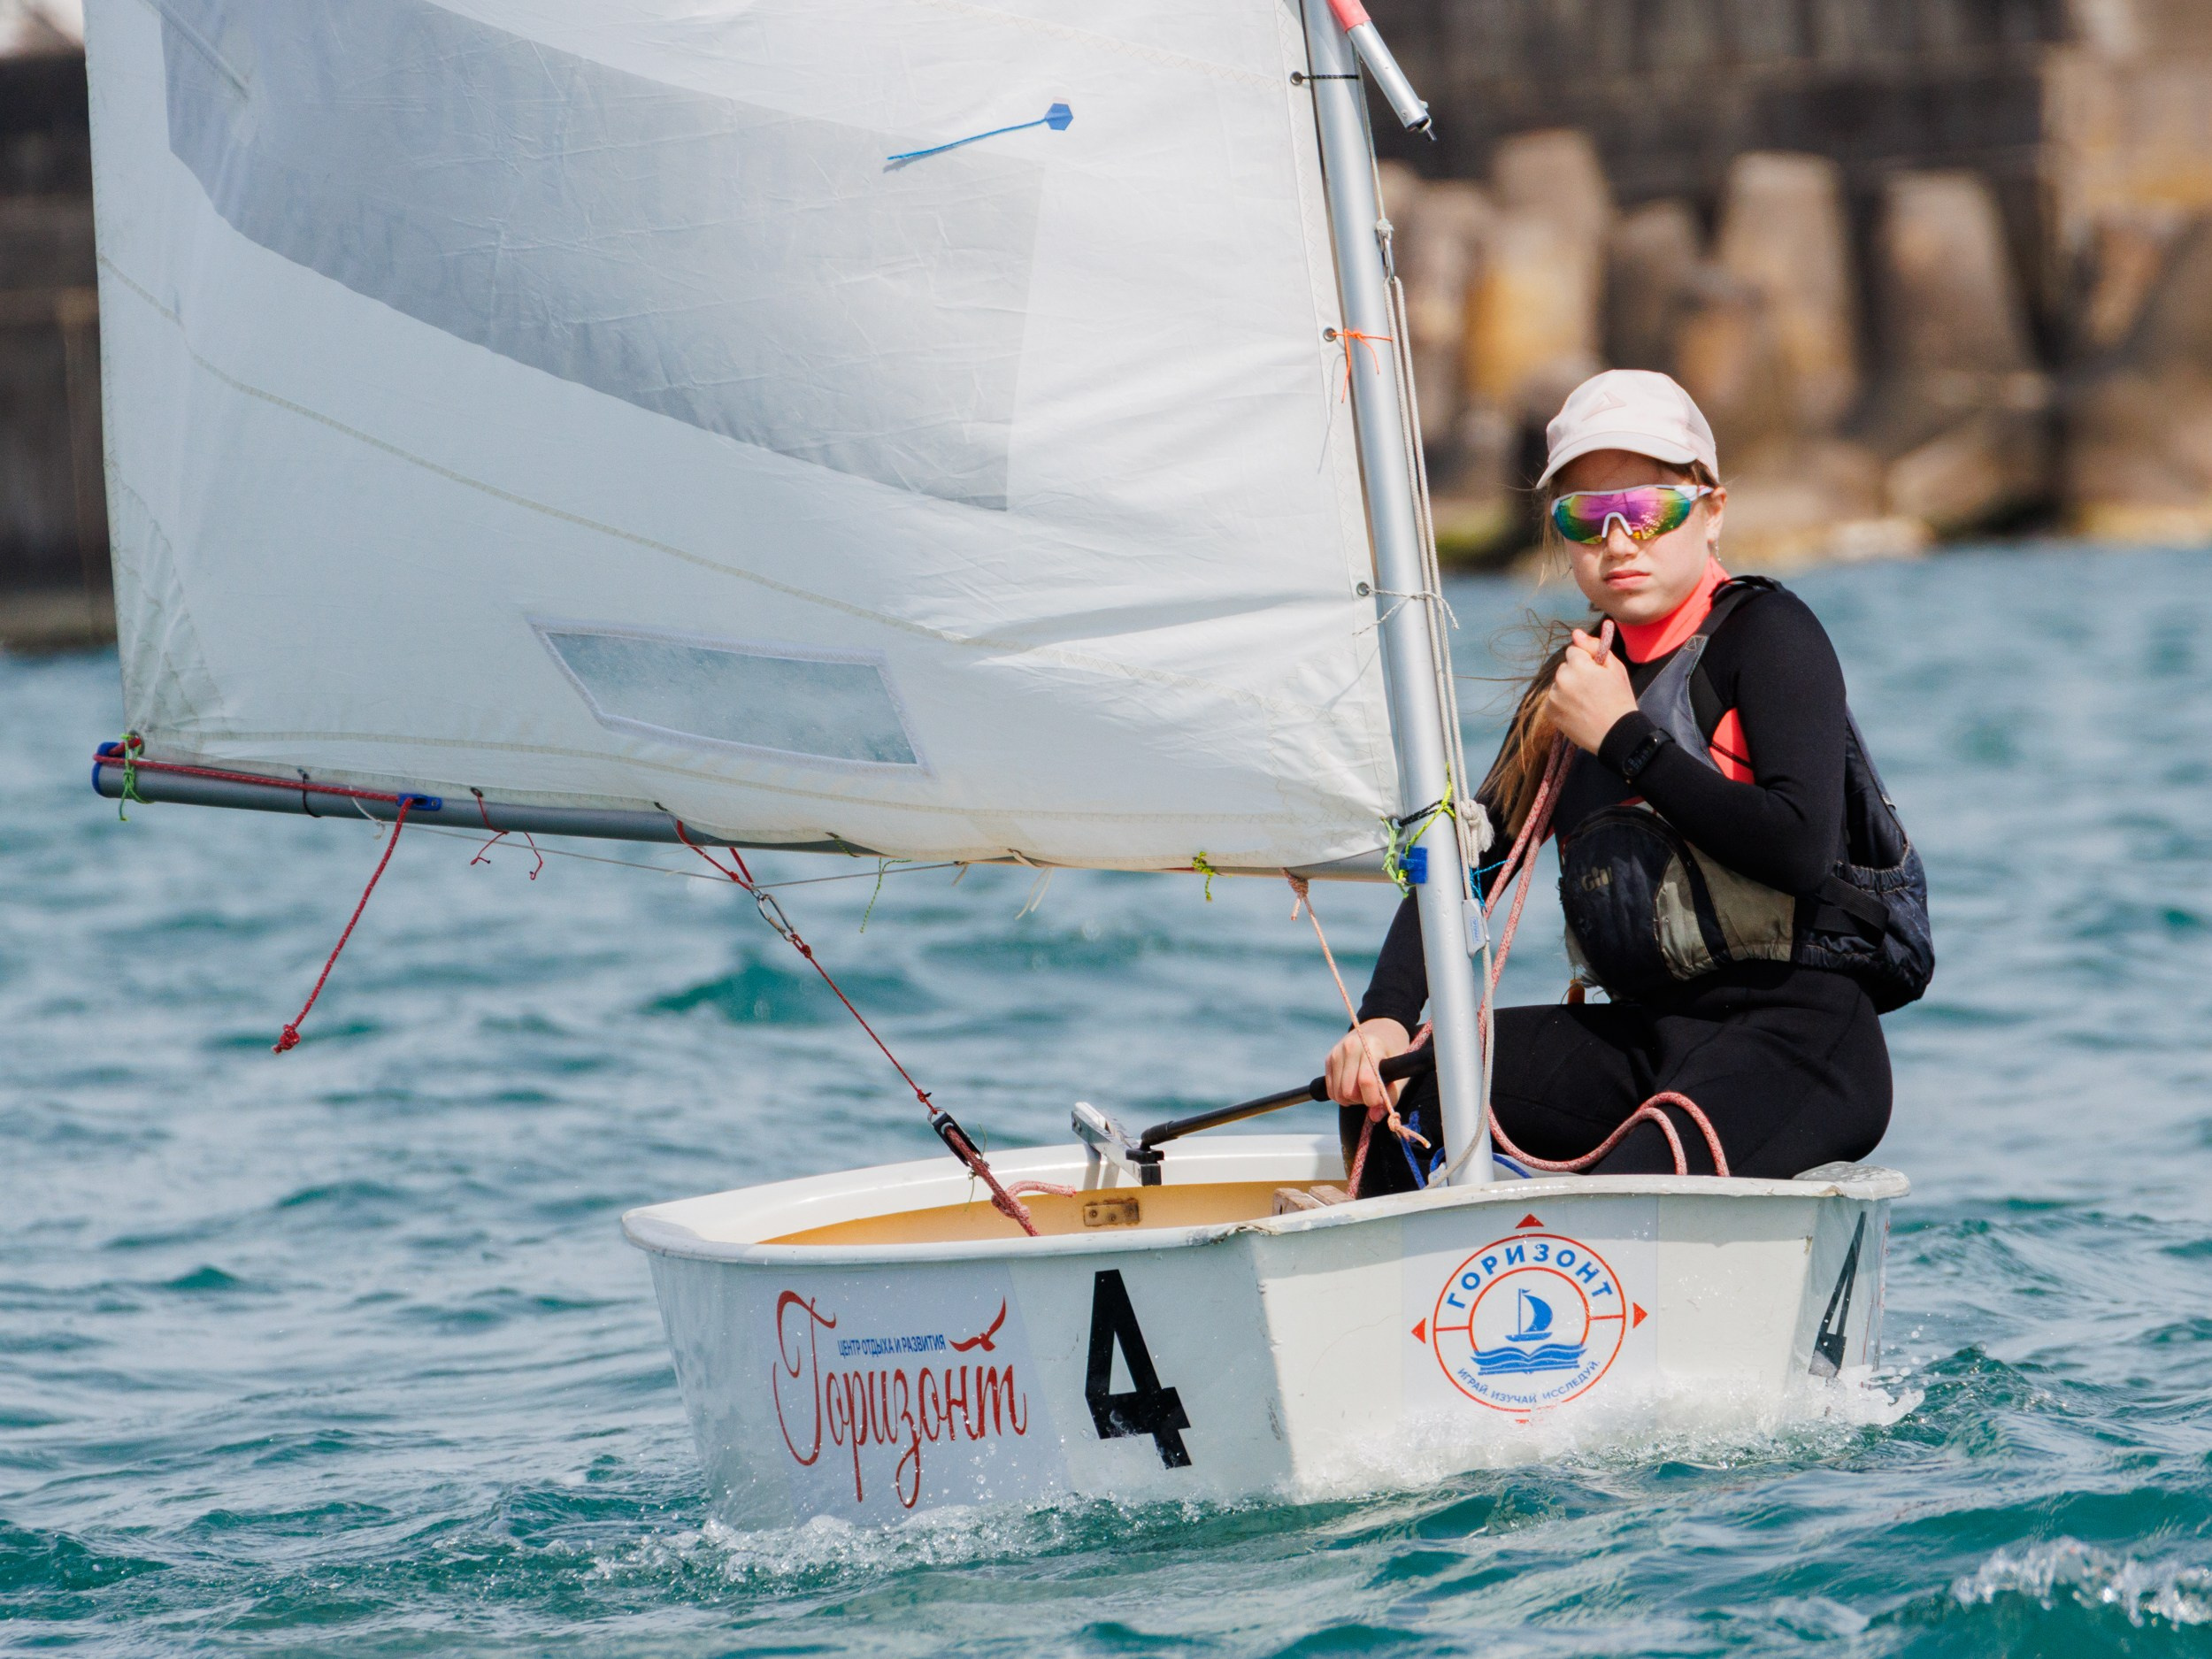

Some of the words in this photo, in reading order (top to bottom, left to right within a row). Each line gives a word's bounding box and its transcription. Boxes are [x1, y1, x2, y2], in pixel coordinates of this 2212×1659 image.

[1447, 1243, 1613, 1310] ГОРИЗОНТ
[772, 1290, 1027, 1509] Горизонт
[837, 1339, 860, 1359] ЦЕНТР
[862, 1337, 894, 1358] ОТДЫХА
[894, 1337, 902, 1354] И
[902, 1333, 947, 1353] РАЗВИТИЯ
[1085, 1269, 1191, 1470] 4
